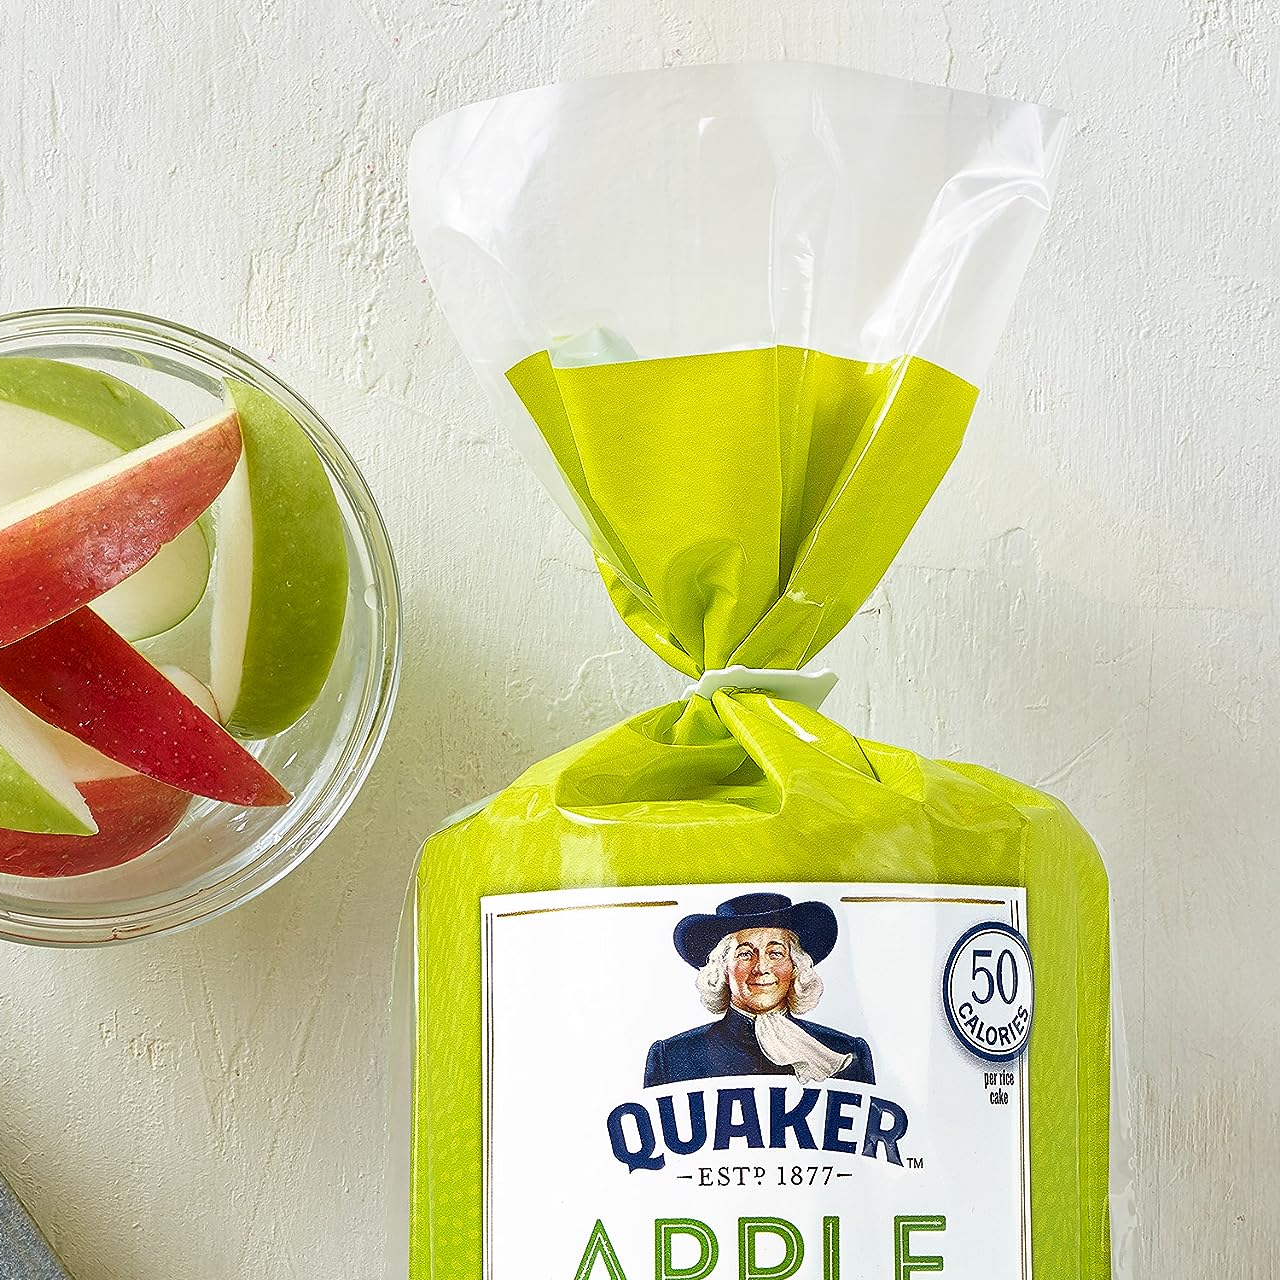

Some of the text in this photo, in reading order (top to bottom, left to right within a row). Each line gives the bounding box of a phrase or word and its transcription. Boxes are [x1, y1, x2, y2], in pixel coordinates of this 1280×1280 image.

[972, 949, 1018, 1004] 50
[958, 1002, 1028, 1046] CALORIES
[984, 1069, 1015, 1089] per rice
[989, 1088, 1008, 1105] cake
[607, 1087, 909, 1174] QUAKER
